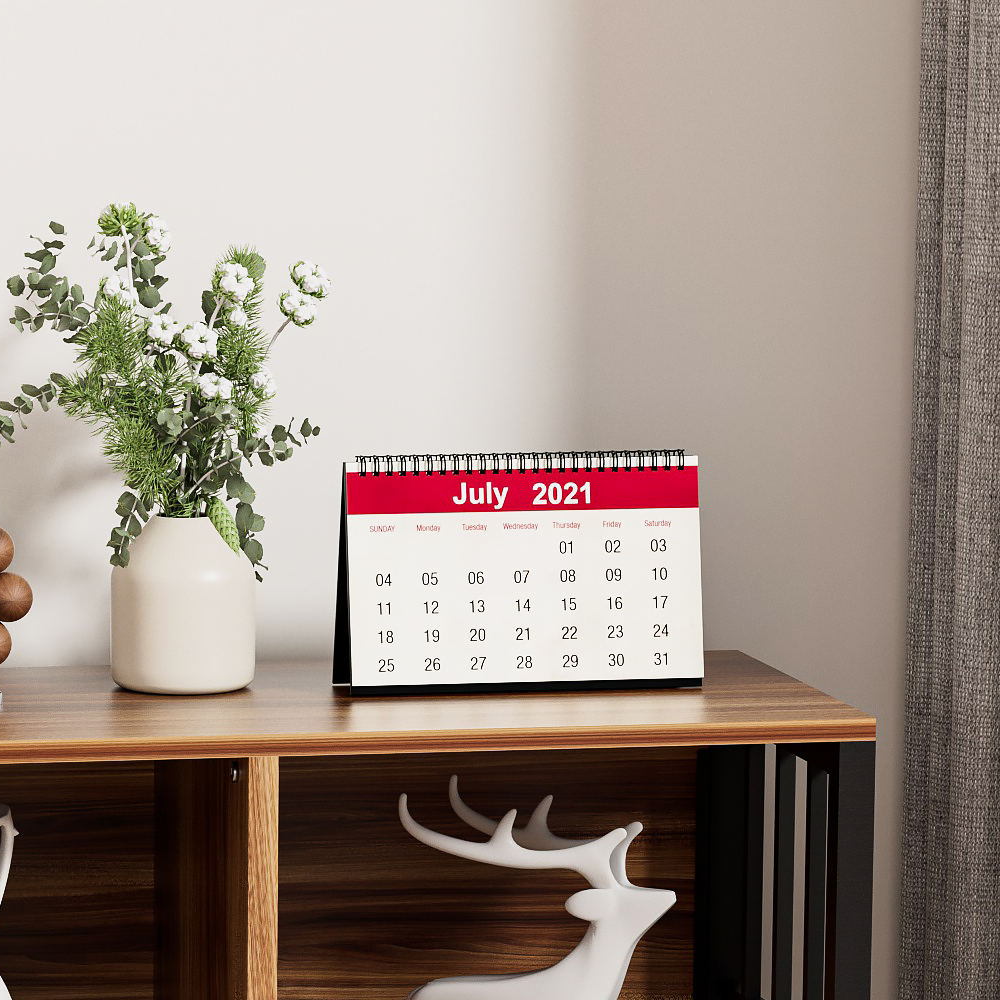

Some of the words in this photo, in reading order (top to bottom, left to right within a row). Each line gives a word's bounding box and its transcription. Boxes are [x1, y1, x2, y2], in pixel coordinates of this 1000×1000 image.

[452, 481, 509, 511] July
[532, 481, 592, 506] 2021
[559, 540, 573, 555] 01
[604, 539, 621, 554] 02
[650, 538, 667, 553] 03
[375, 573, 393, 587] 04
[421, 571, 439, 586] 05
[467, 571, 485, 585] 06
[513, 569, 530, 584] 07
[559, 569, 576, 583] 08
[605, 568, 622, 582] 09
[651, 566, 668, 581] 10
[377, 601, 391, 616] 11
[423, 600, 439, 615] 12
[469, 599, 486, 613] 13
[515, 598, 531, 612] 14
[561, 597, 577, 611] 15
[606, 596, 623, 610] 16
[652, 595, 669, 609] 17
[377, 630, 394, 644] 18
[424, 629, 440, 643] 19
[469, 628, 486, 642] 20
[515, 627, 530, 641] 21
[561, 625, 578, 640] 22
[607, 624, 624, 639] 23
[652, 623, 669, 638] 24
[378, 658, 395, 673] 25
[424, 657, 441, 672] 26
[470, 656, 487, 671] 27
[516, 655, 533, 669] 28
[562, 654, 579, 668] 29
[608, 653, 625, 667] 30
[653, 652, 668, 666] 31
